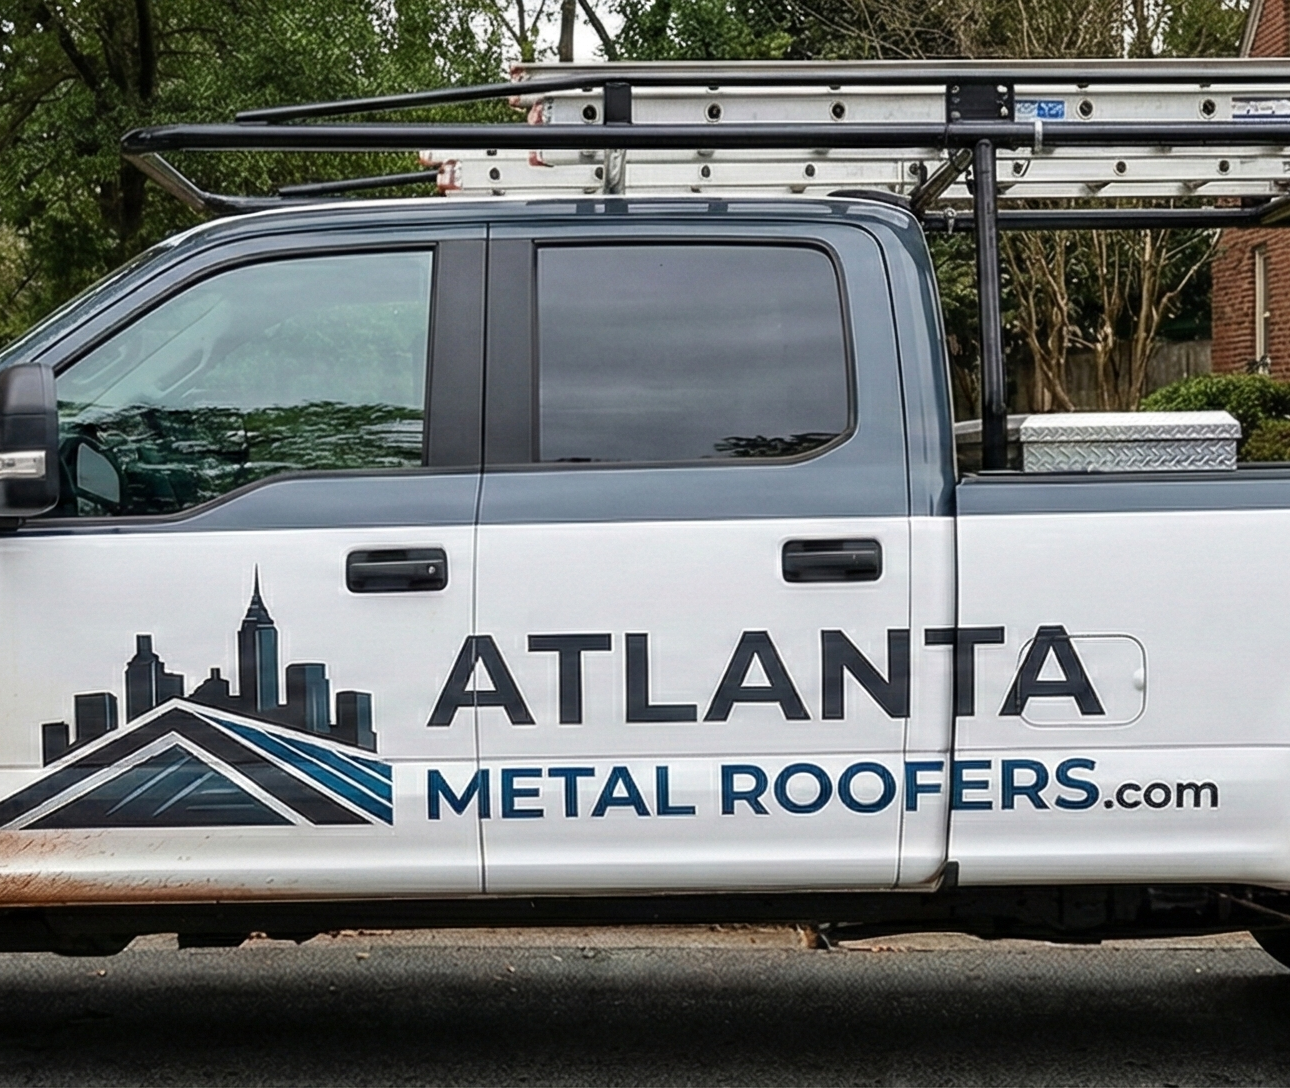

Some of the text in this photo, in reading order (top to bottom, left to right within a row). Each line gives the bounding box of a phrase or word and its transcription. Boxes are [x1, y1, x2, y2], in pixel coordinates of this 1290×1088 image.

[427, 625, 1106, 726] ATLANTA
[427, 758, 1218, 820] METAL ROOFERS.com
